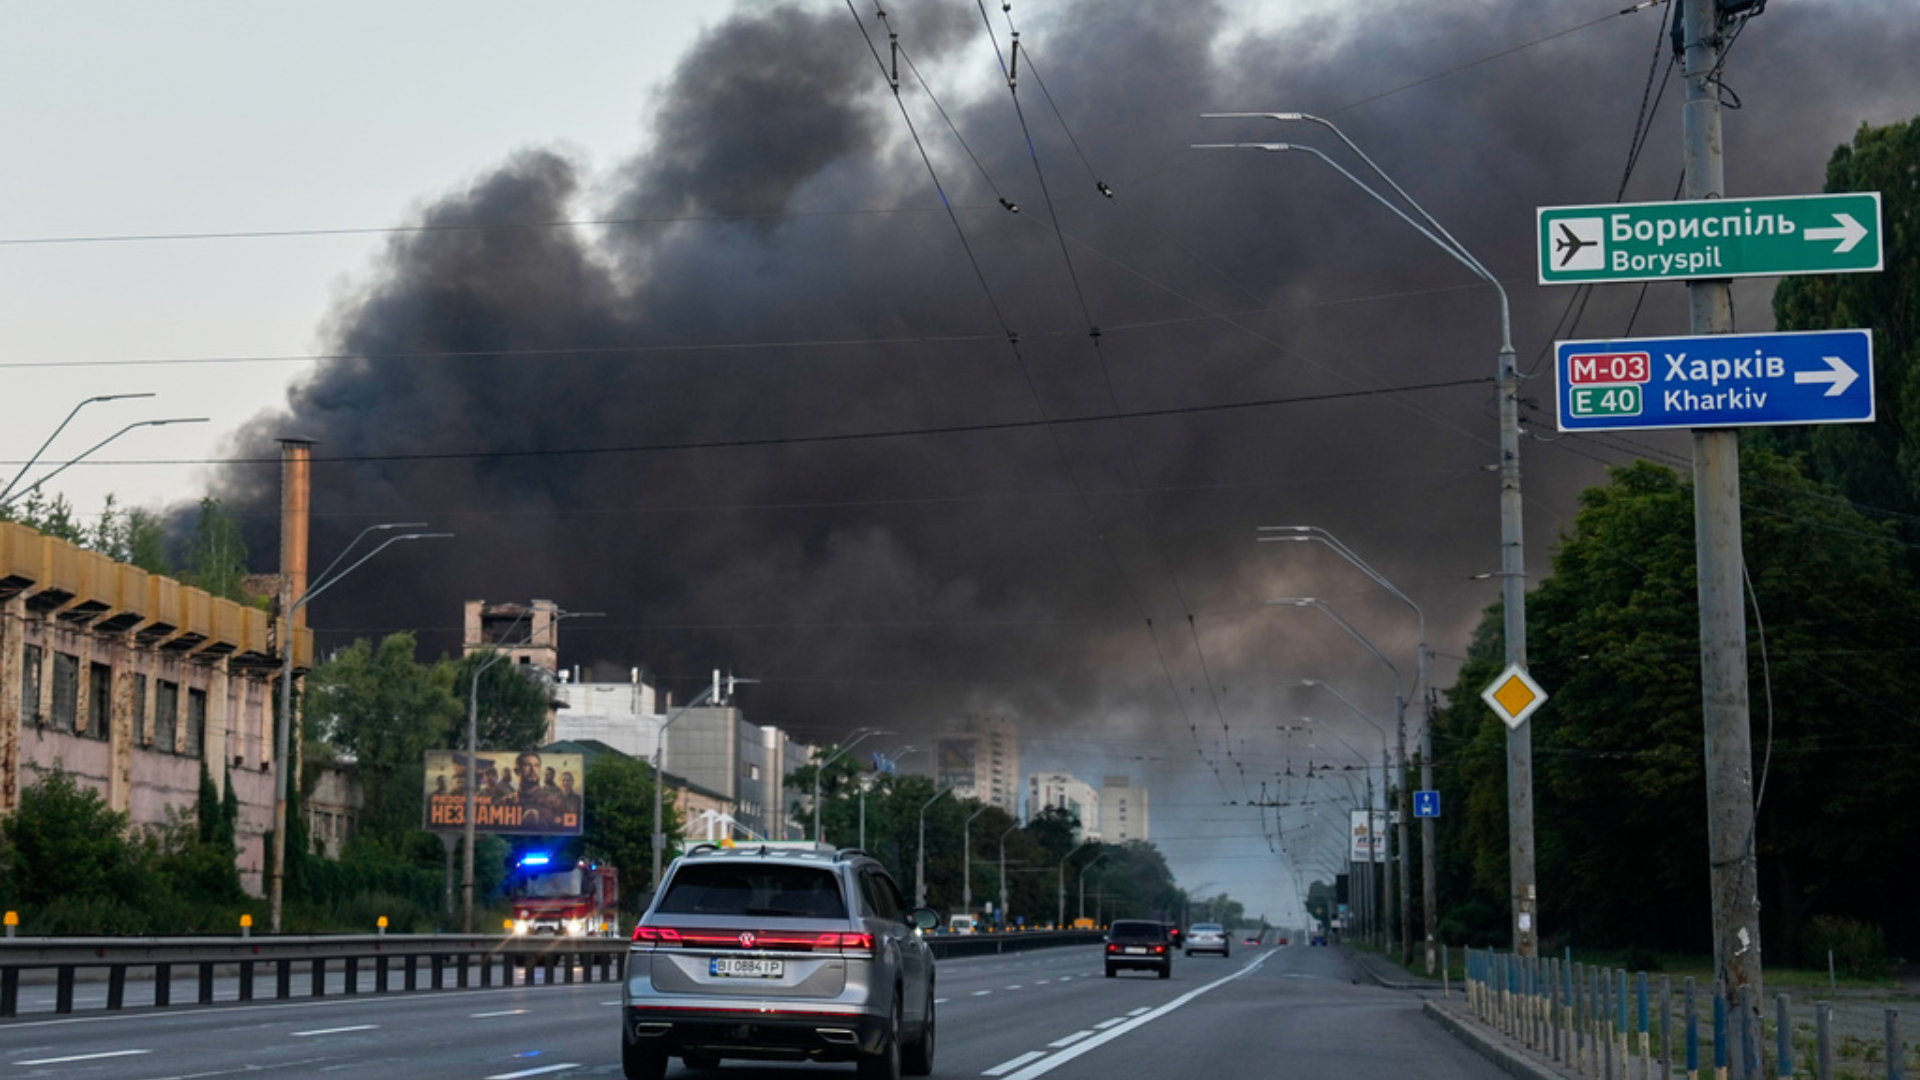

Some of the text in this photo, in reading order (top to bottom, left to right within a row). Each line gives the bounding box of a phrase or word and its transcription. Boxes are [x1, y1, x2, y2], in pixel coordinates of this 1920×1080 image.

[1611, 208, 1796, 246] Бориспіль
[1611, 246, 1722, 274] Boryspil
[1664, 350, 1785, 386] Харків
[1576, 389, 1635, 413] E 40
[1664, 388, 1767, 411] Kharkiv
